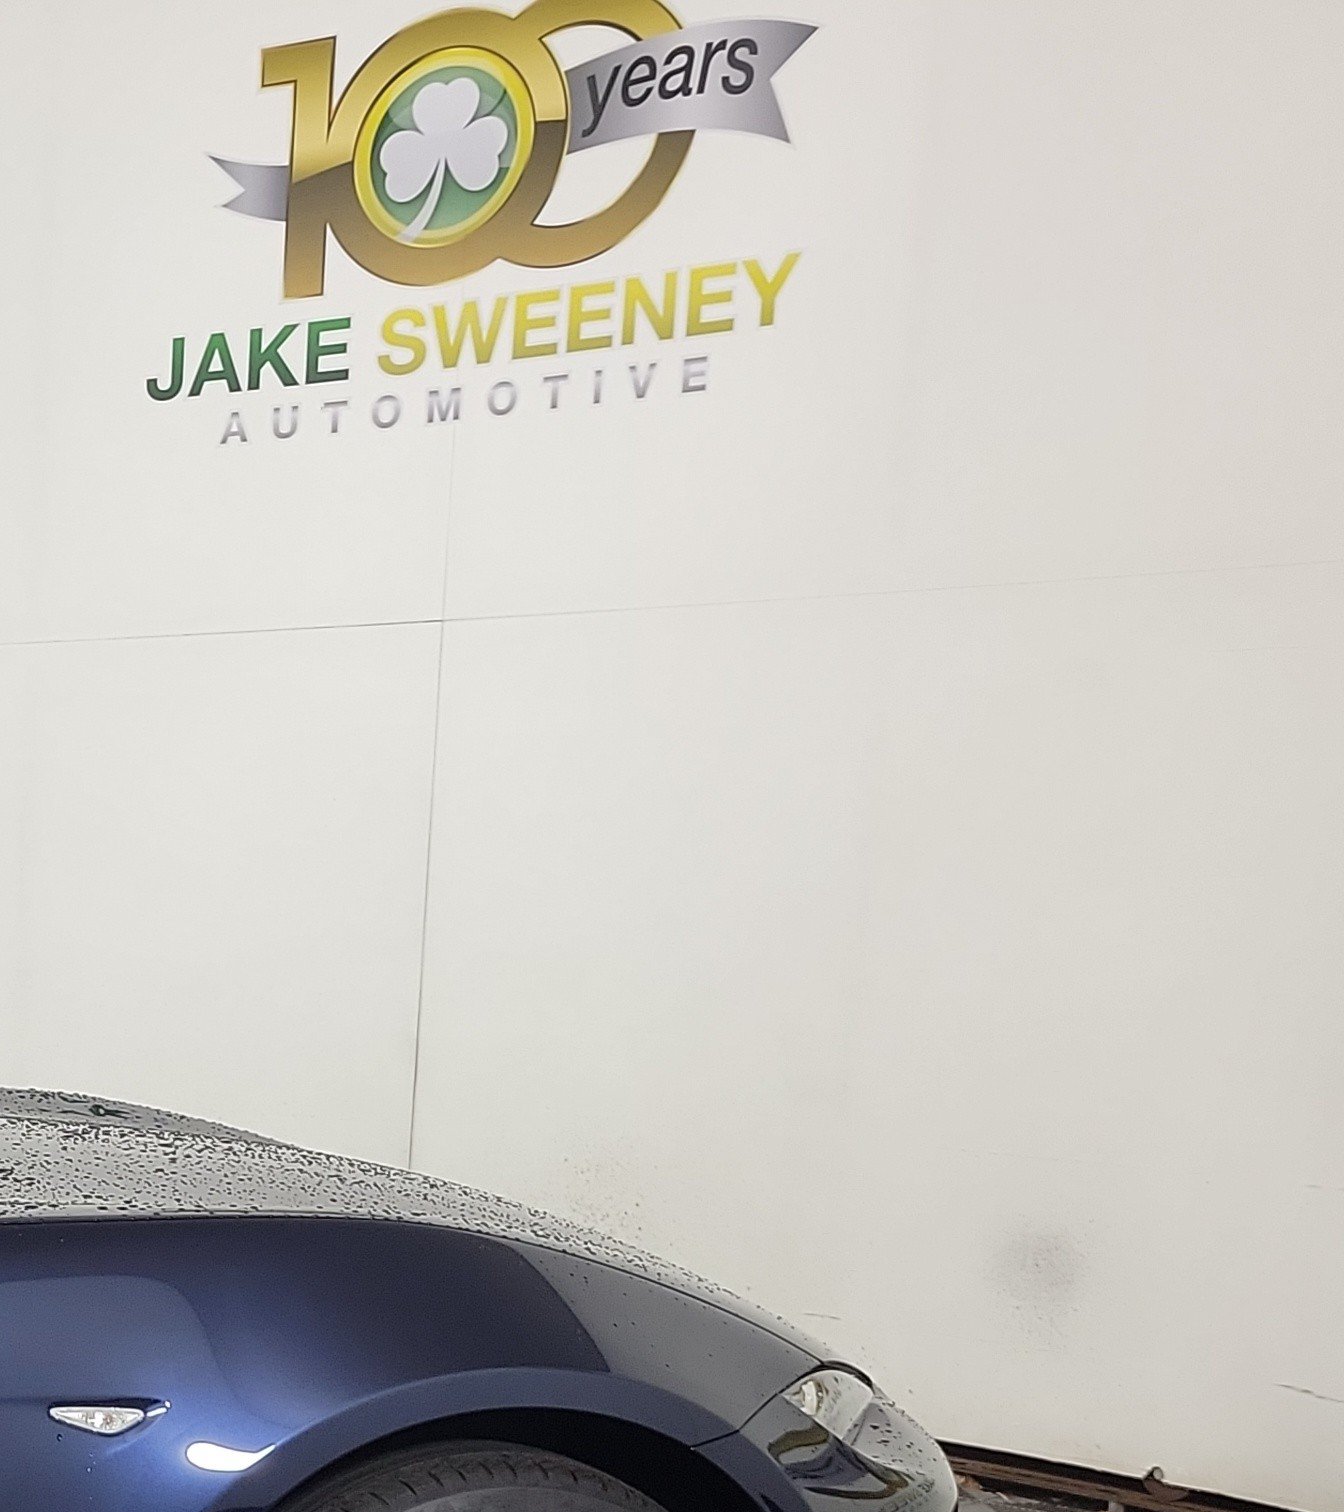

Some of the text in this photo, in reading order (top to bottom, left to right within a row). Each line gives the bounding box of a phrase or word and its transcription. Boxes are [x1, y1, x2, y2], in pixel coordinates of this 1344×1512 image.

[580, 36, 758, 138] years
[146, 251, 803, 402] JAKE SWEENEY
[218, 356, 709, 446] AUTOMOTIVE
